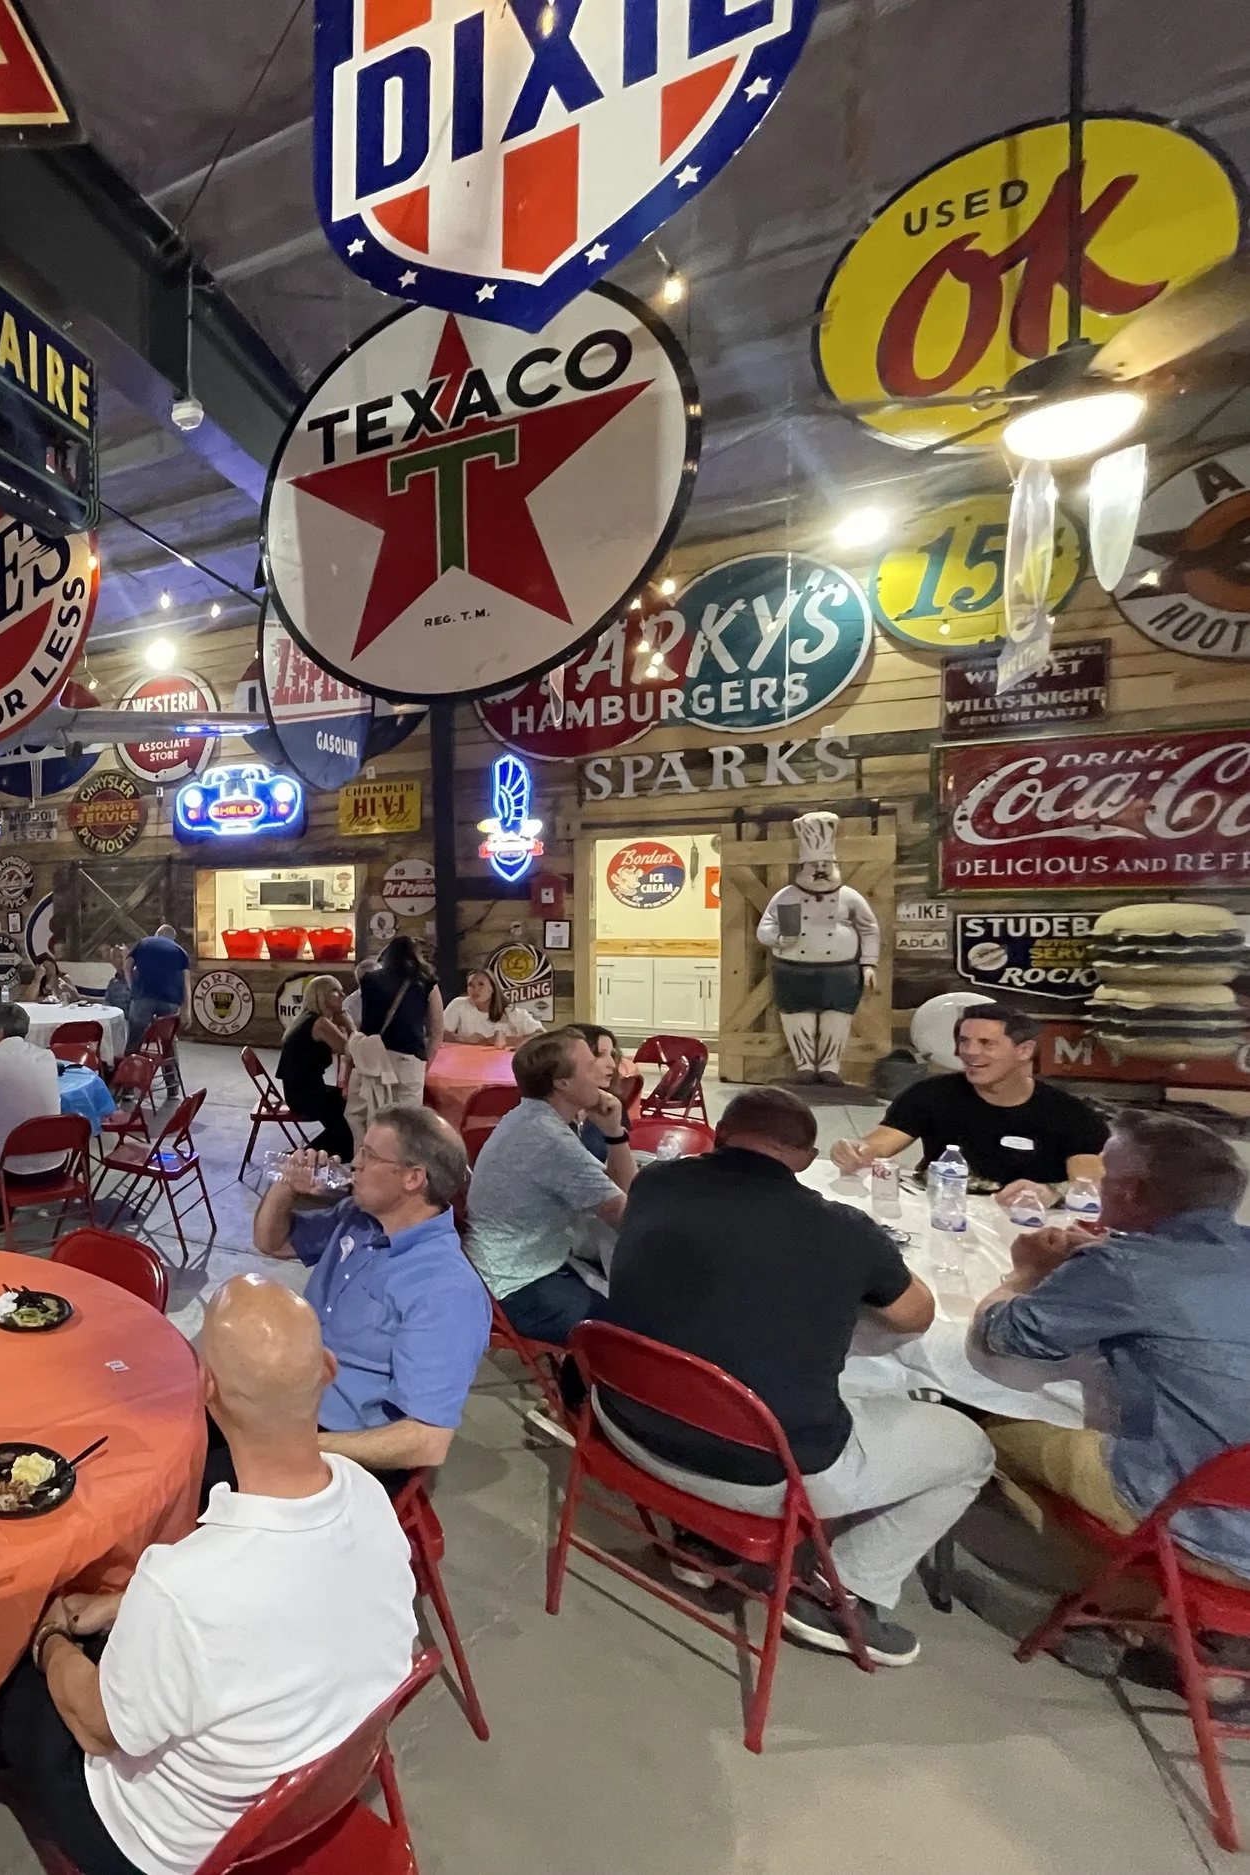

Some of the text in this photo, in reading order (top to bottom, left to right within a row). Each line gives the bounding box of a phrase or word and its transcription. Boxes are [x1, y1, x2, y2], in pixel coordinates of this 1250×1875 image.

[902, 179, 1029, 237] USED
[876, 160, 1169, 399] OK
[306, 328, 634, 465] TEXACO
[30, 576, 86, 689] LESS
[484, 568, 853, 704] ARKY'S
[132, 690, 199, 713] WESTERN
[511, 672, 810, 735] HAMBURGERS
[138, 738, 191, 753] ASSOCIATE
[316, 730, 358, 759] GASOLINE
[149, 751, 180, 762] STORE
[583, 725, 854, 802] SPARKS
[1056, 745, 1188, 768] DRINK
[80, 774, 136, 802] CHRYSLER
[345, 783, 415, 797] CHAMPLIN
[952, 742, 1250, 846] Coca-Co
[76, 809, 141, 824] SERVICE
[82, 803, 134, 813] APPROVED
[212, 803, 263, 816] SHELBY
[78, 824, 138, 853] PLYMOUTH
[619, 849, 676, 866] Borden's
[955, 855, 1109, 877] DELICIOUS
[1116, 858, 1168, 873] AND
[398, 880, 436, 896] Peppe
[640, 883, 674, 894] CREAM
[649, 873, 665, 883] ICE
[918, 904, 947, 919] IKE
[964, 916, 1091, 938] STUDEB
[897, 938, 946, 949] ADLAI
[1030, 947, 1087, 960] SERV
[194, 973, 252, 1004] LORECO
[502, 981, 552, 1004] ERLING
[207, 1021, 241, 1034] GAS
